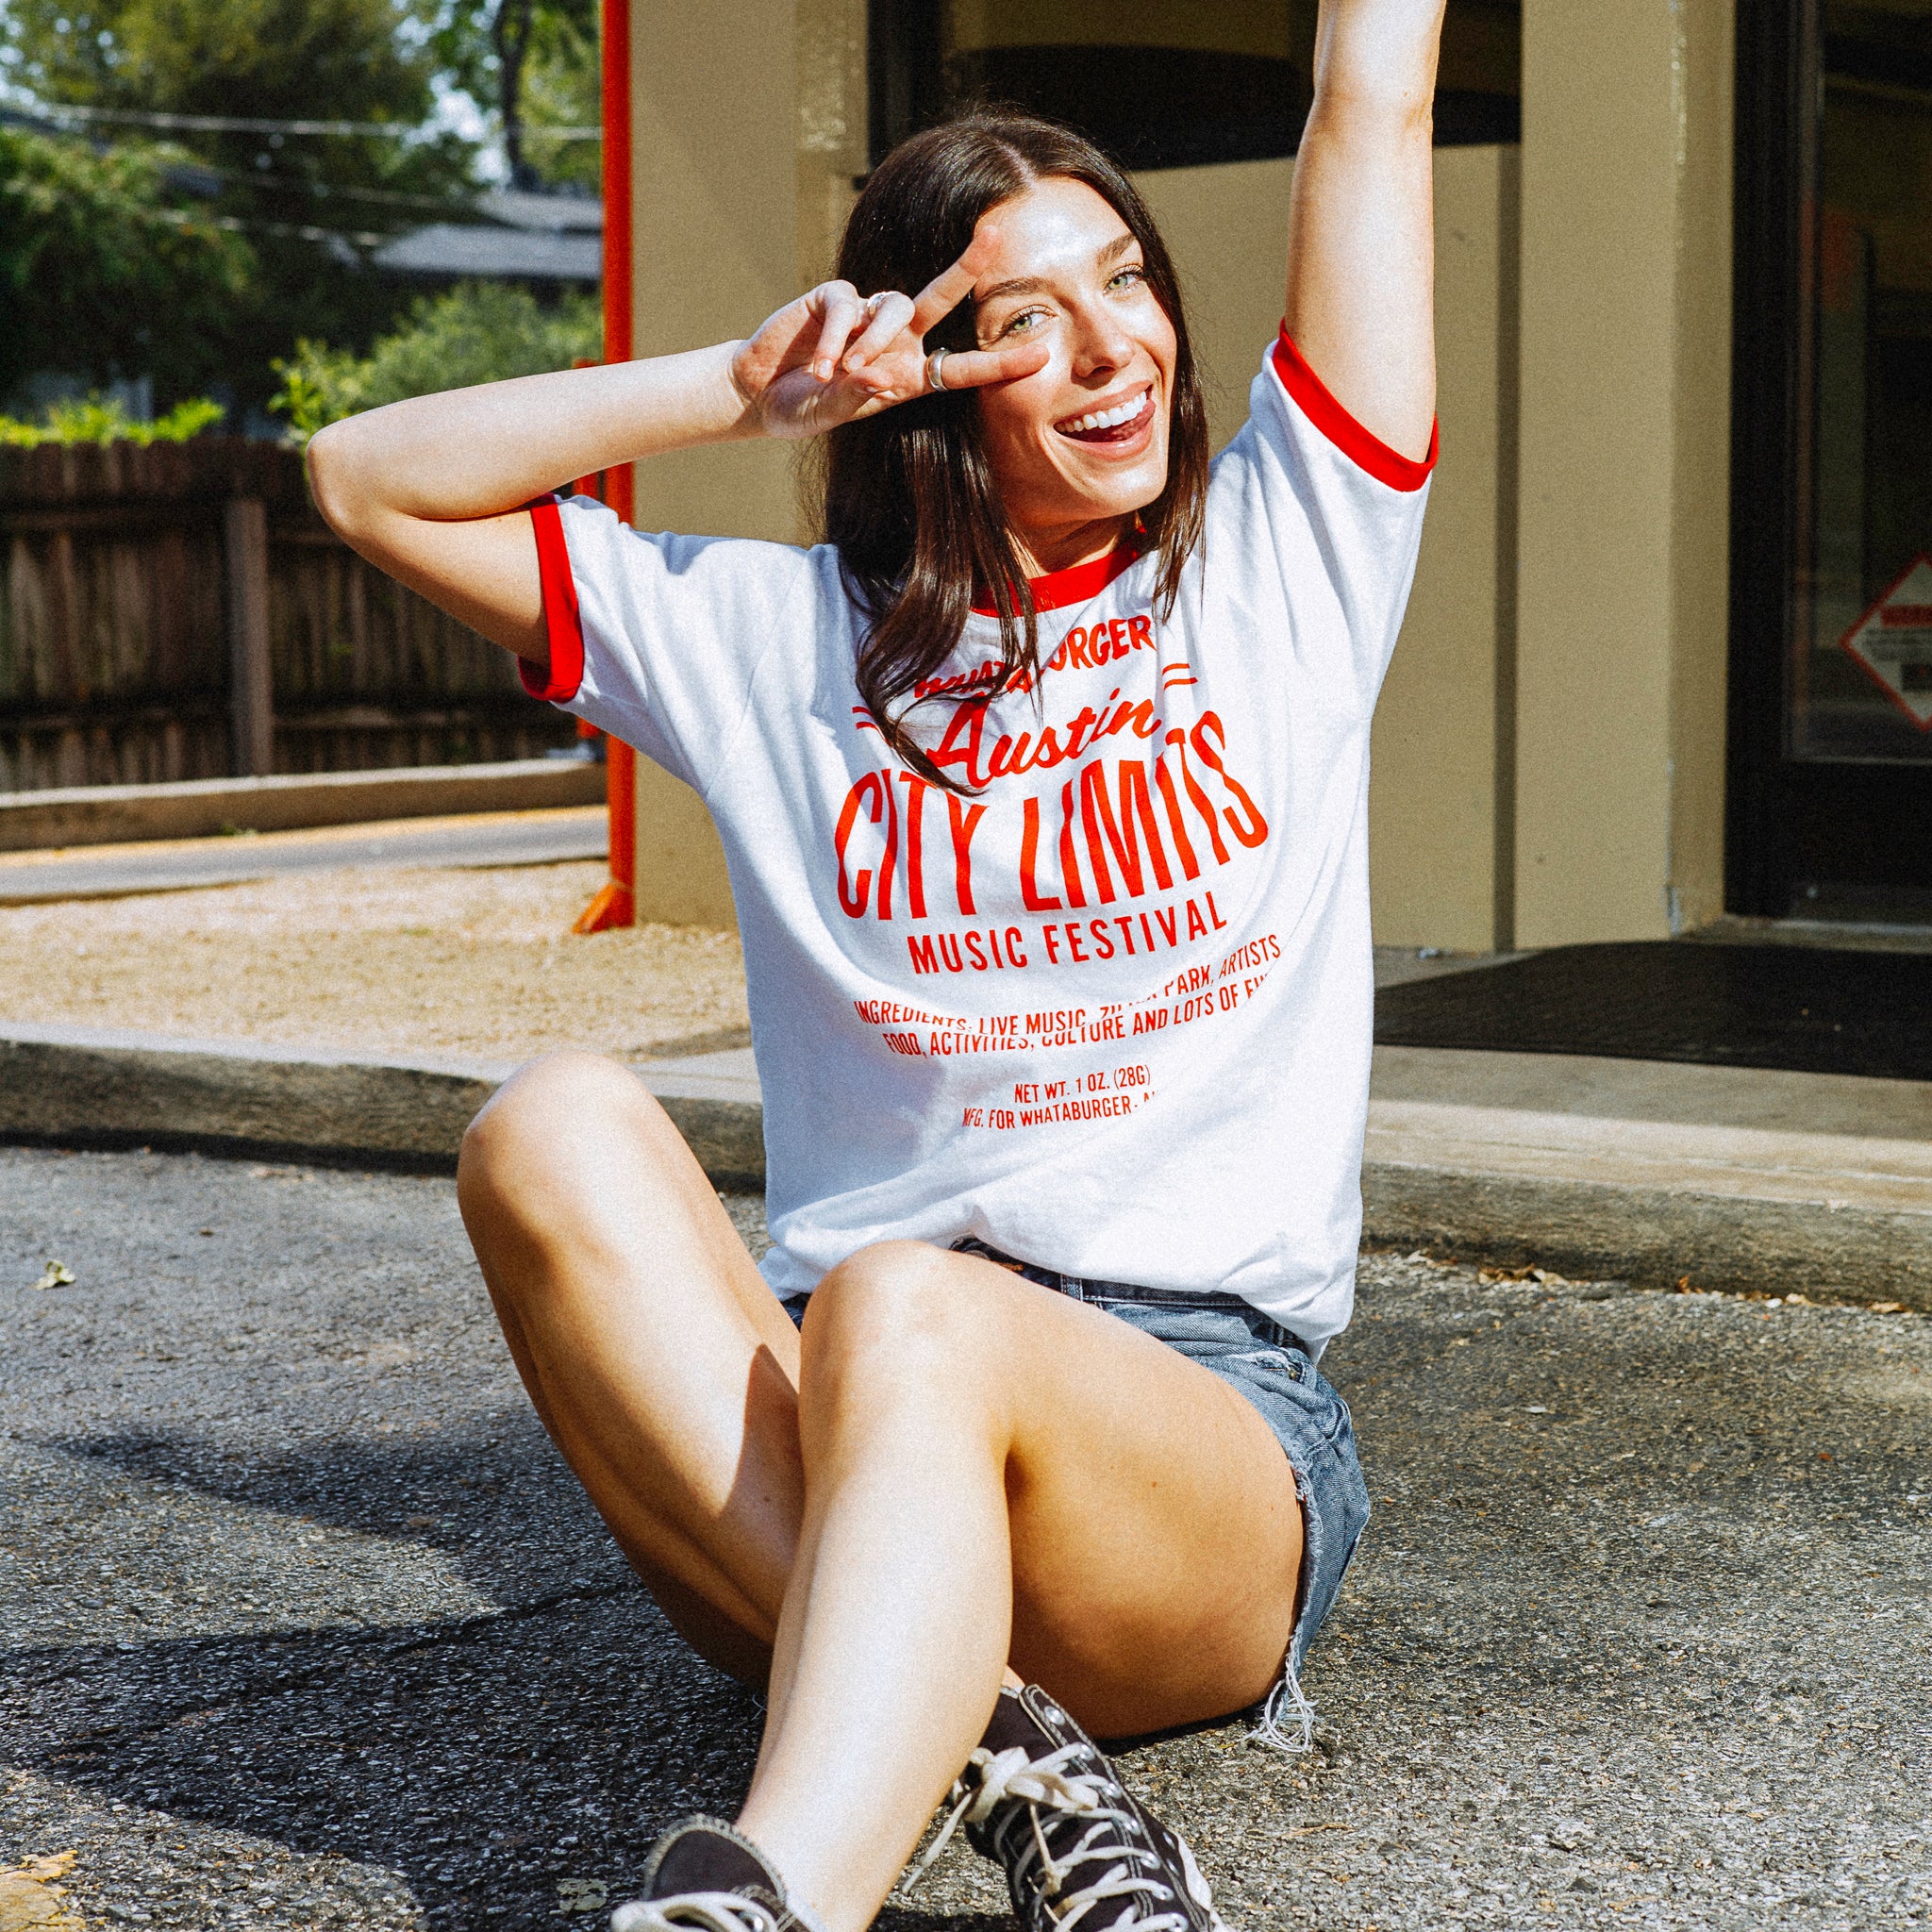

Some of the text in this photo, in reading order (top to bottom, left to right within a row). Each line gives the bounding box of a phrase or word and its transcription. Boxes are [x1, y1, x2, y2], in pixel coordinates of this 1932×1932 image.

[914, 614, 1158, 698] WHATAURGER
[925, 687, 1161, 789] Austin
[835, 710, 1269, 920] CITY LIMITS
[907, 891, 1227, 974] MUSIC FESTIVAL
[979, 1014, 1018, 1036] LIVE
[1218, 934, 1281, 980] ARTISTS
[1133, 1008, 1169, 1036] AND
[1174, 992, 1215, 1025] LOTS
[1219, 984, 1239, 1011] OF
[988, 1108, 1016, 1130] FOR
[1014, 1064, 1151, 1104] NET WT. 1 OZ. (28G)
